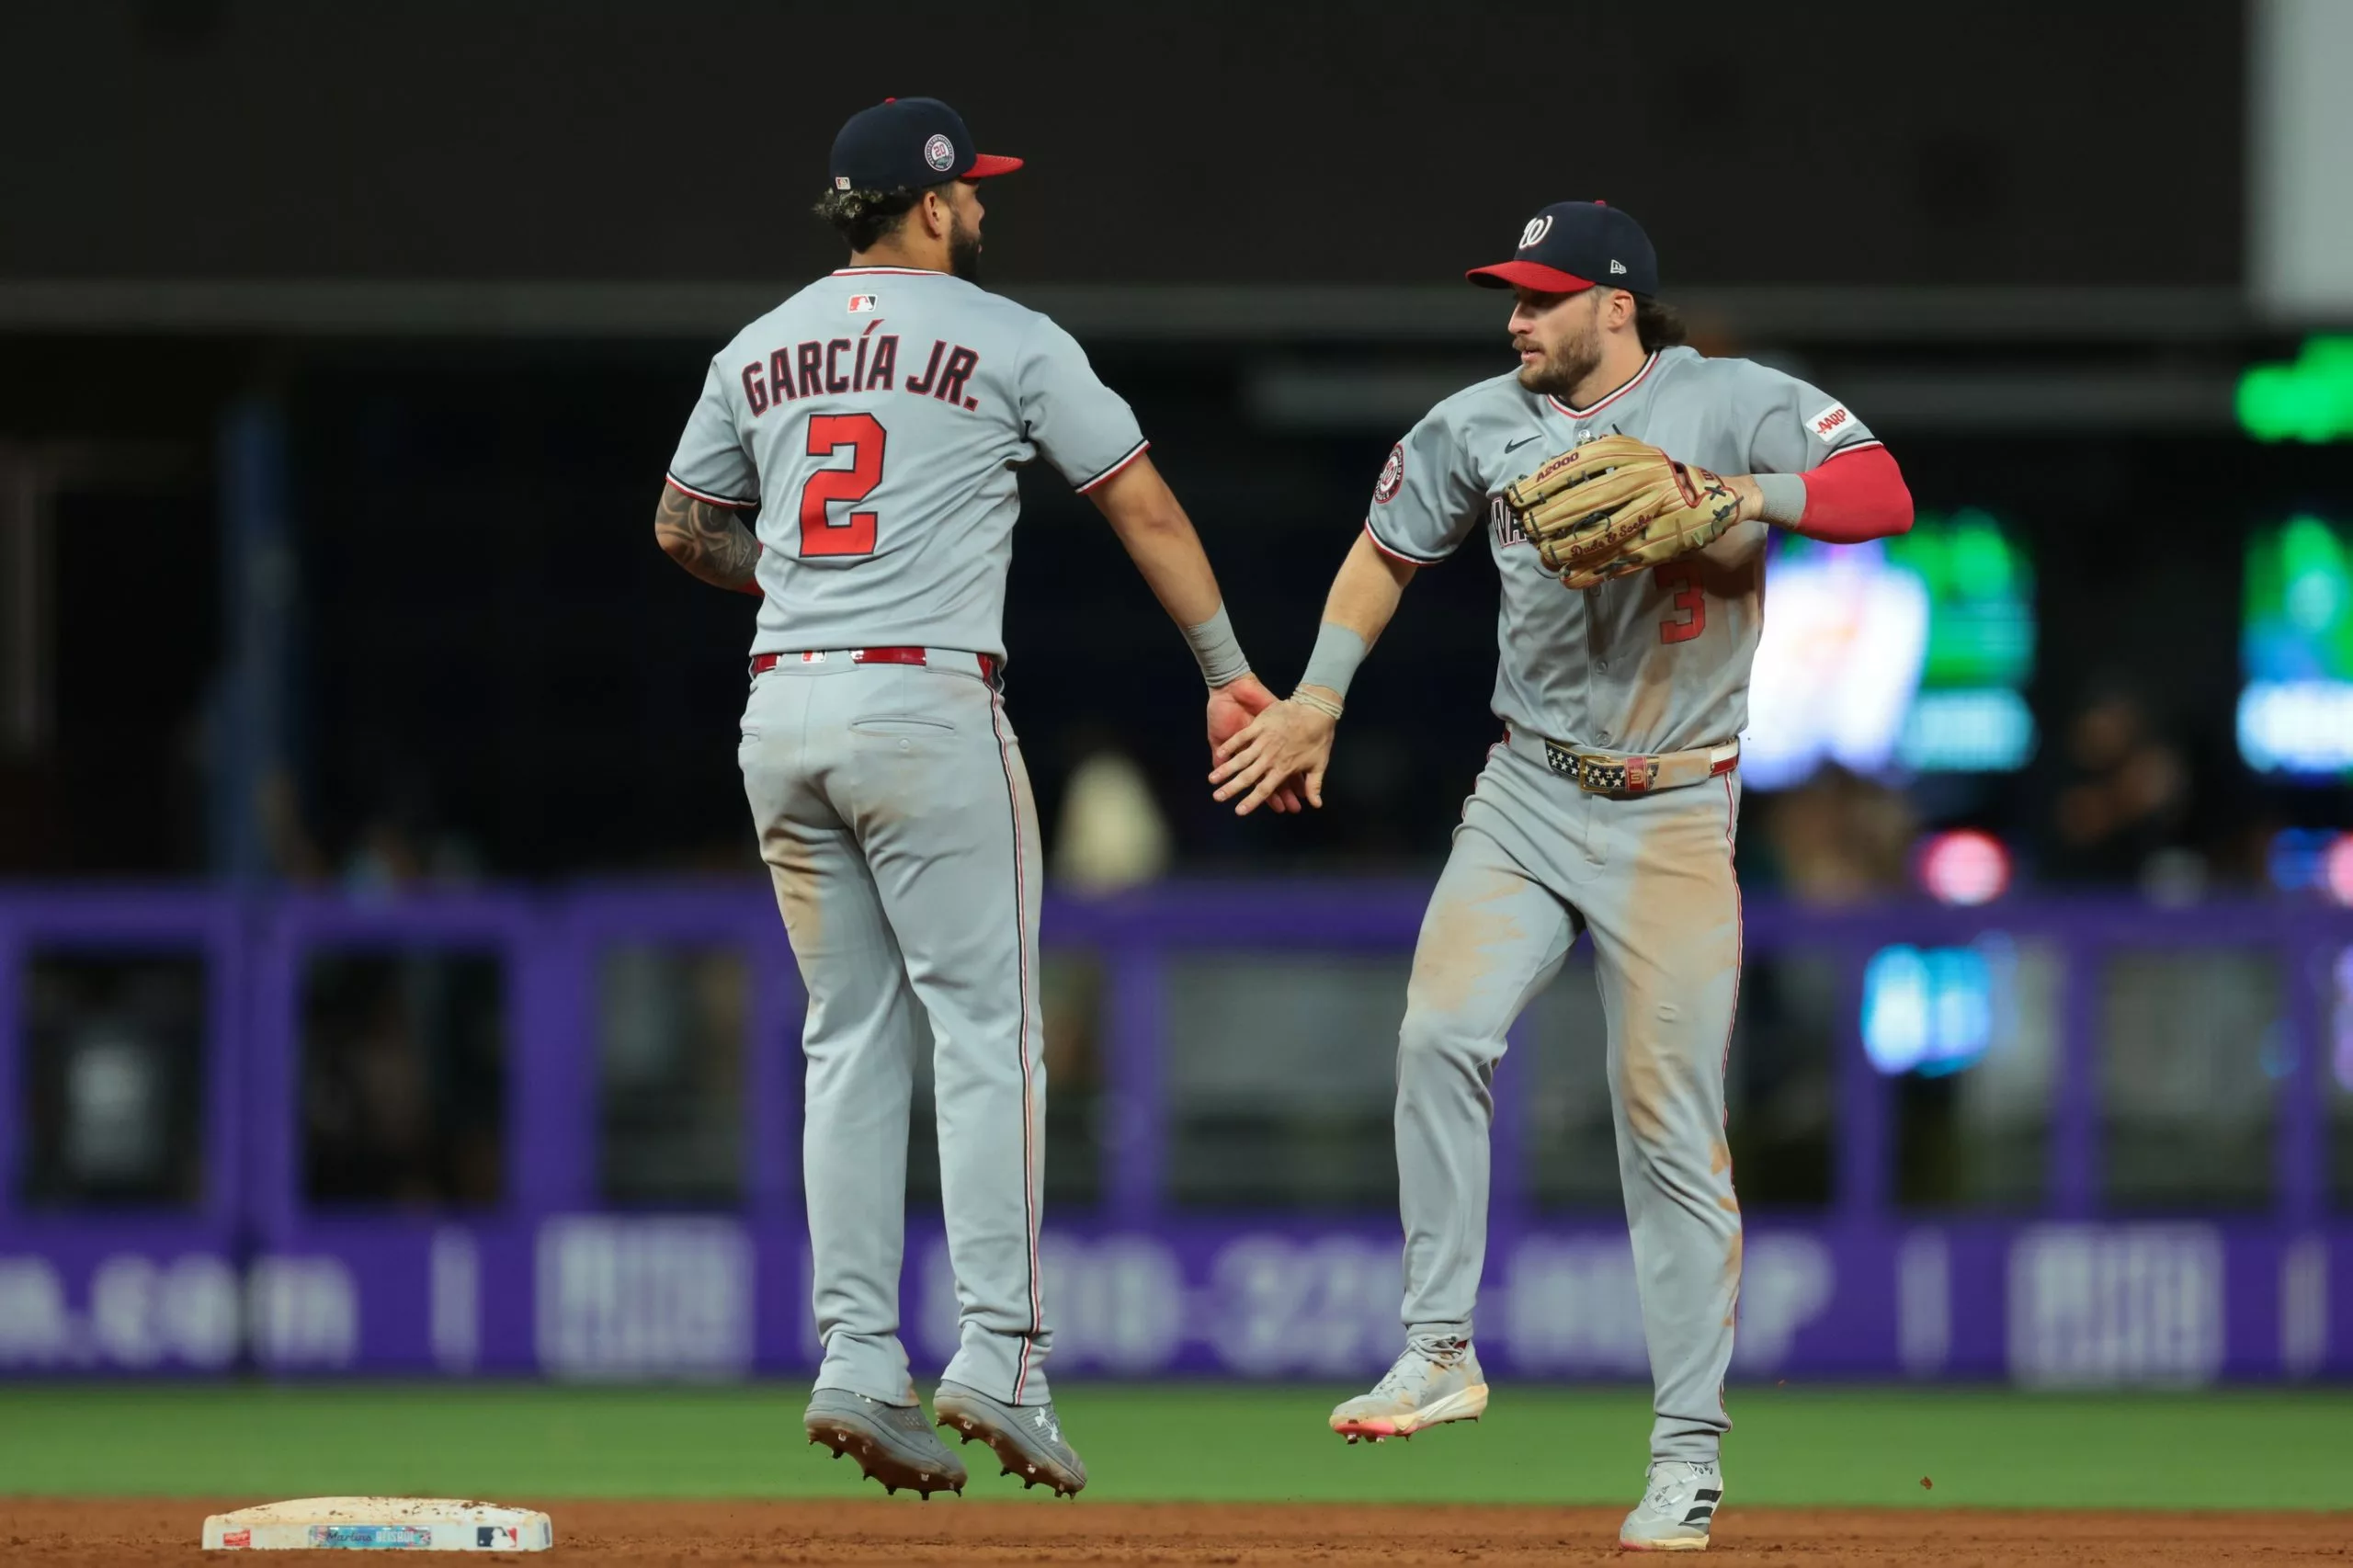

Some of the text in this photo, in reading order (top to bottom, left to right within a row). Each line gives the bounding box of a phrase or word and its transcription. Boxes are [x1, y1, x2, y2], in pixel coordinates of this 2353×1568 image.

[933, 143, 947, 157] 20
[1518, 215, 1553, 250] W
[741, 318, 979, 417] GARCÍA JR.
[1817, 409, 1847, 434] AARP
[1536, 451, 1579, 483] A2000
[799, 413, 887, 558] 2
[1655, 562, 1706, 645] 3
